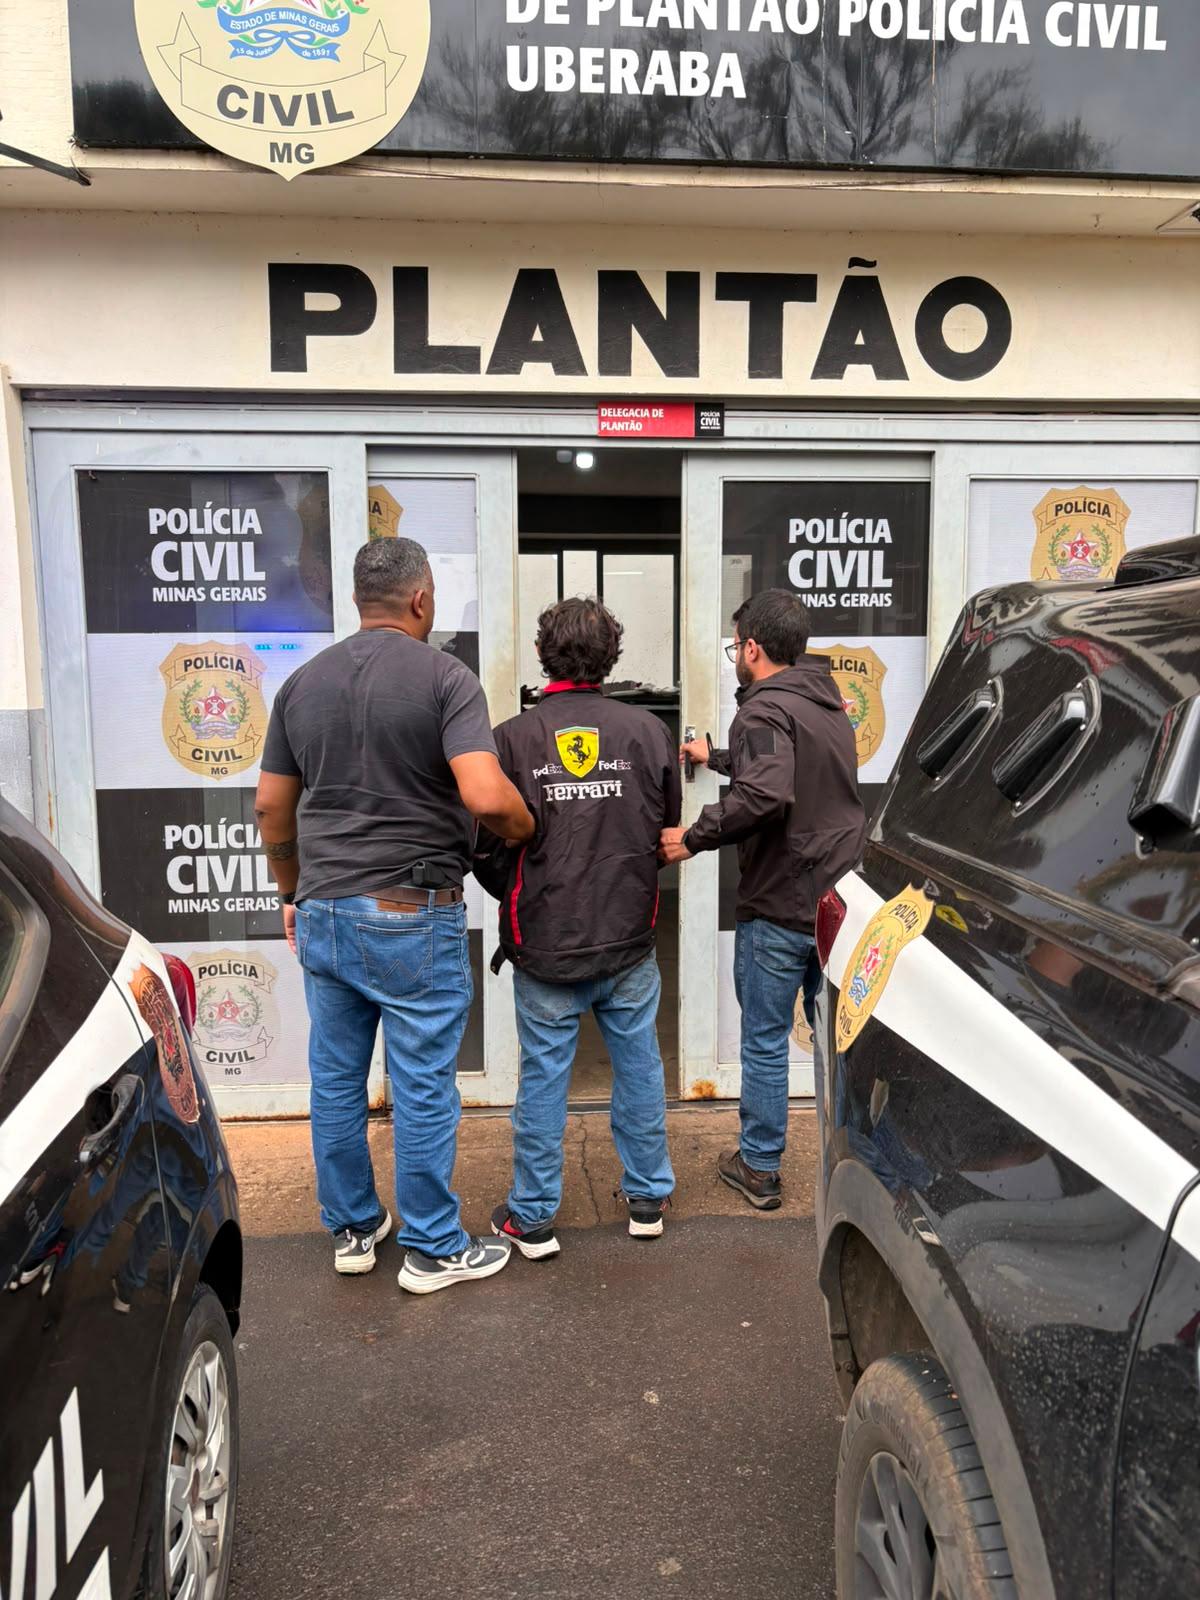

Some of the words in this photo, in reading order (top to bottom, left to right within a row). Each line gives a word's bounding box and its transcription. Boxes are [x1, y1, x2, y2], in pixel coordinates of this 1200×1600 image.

[230, 14, 263, 30] ESTADO
[264, 11, 277, 22] DE
[278, 10, 307, 24] MINAS
[308, 19, 340, 33] GERAIS
[505, 0, 570, 24] DE
[1045, 1, 1166, 51] CIVIL
[506, 45, 747, 98] UBERABA
[216, 84, 355, 127] CIVIL
[269, 142, 315, 164] MG
[268, 257, 1012, 381] PLANTÃO
[600, 408, 649, 418] DELEGACIA
[651, 408, 664, 418] DE
[700, 417, 720, 426] CIVIL
[600, 420, 643, 431] PLANTÃO
[149, 501, 262, 535] POLÍCIA
[1055, 498, 1111, 518] POLÍCIA
[789, 512, 893, 543] POLÍCIA
[151, 541, 266, 581] CIVIL
[788, 549, 893, 588] CIVIL
[152, 588, 206, 602] MINAS
[210, 587, 267, 601] GERAIS
[840, 593, 893, 607] GERAIS
[183, 652, 246, 673] POLÍCIA
[831, 656, 868, 675] LÍCIA
[191, 748, 243, 762] CIVIL
[598, 759, 632, 771] FedEx
[210, 767, 228, 775] MG
[542, 780, 622, 801] Ferrari
[166, 855, 279, 893] CIVIL
[168, 899, 220, 913] MINAS
[224, 897, 280, 912] GERAIS
[198, 960, 259, 979] POLÍCIA
[206, 1050, 255, 1064] CIVIL
[225, 1067, 241, 1075] MG
